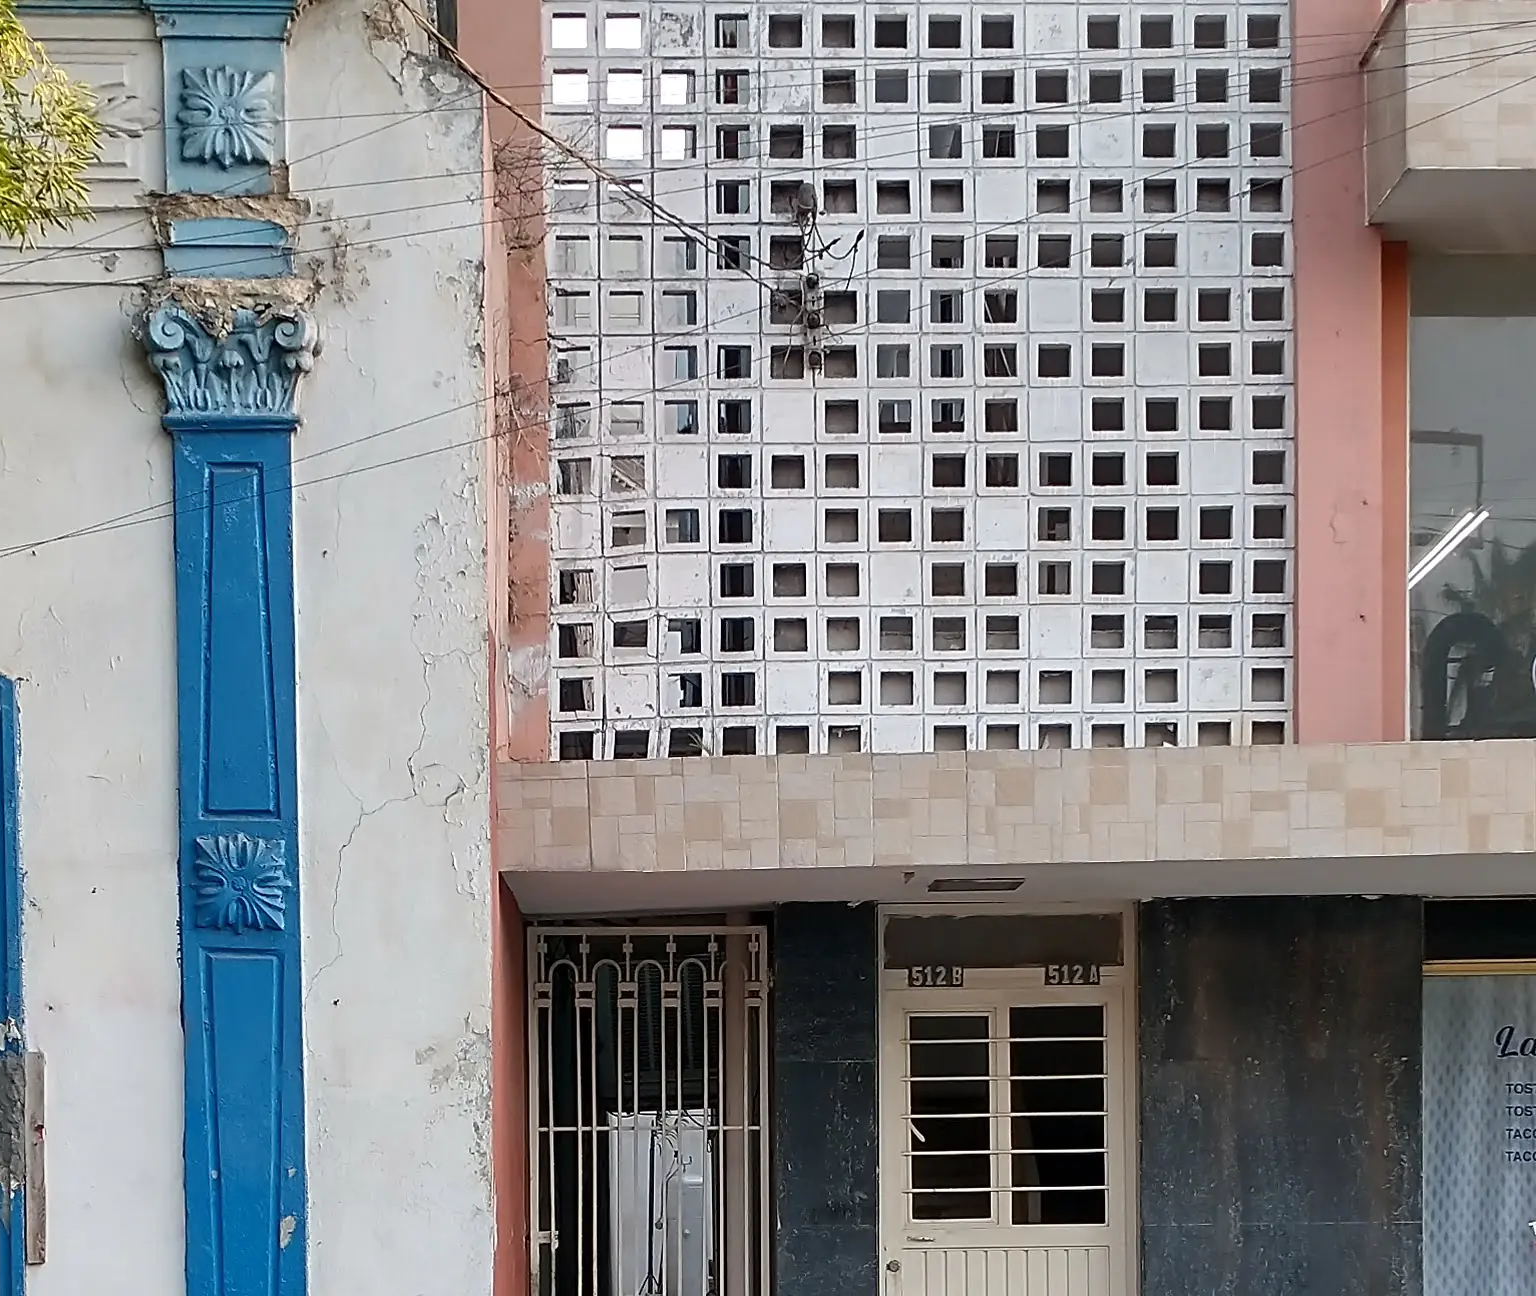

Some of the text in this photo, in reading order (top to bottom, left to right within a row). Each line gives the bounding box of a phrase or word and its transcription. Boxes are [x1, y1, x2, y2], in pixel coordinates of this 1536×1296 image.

[911, 965, 963, 987] 512 B
[1047, 963, 1099, 984] 512 A
